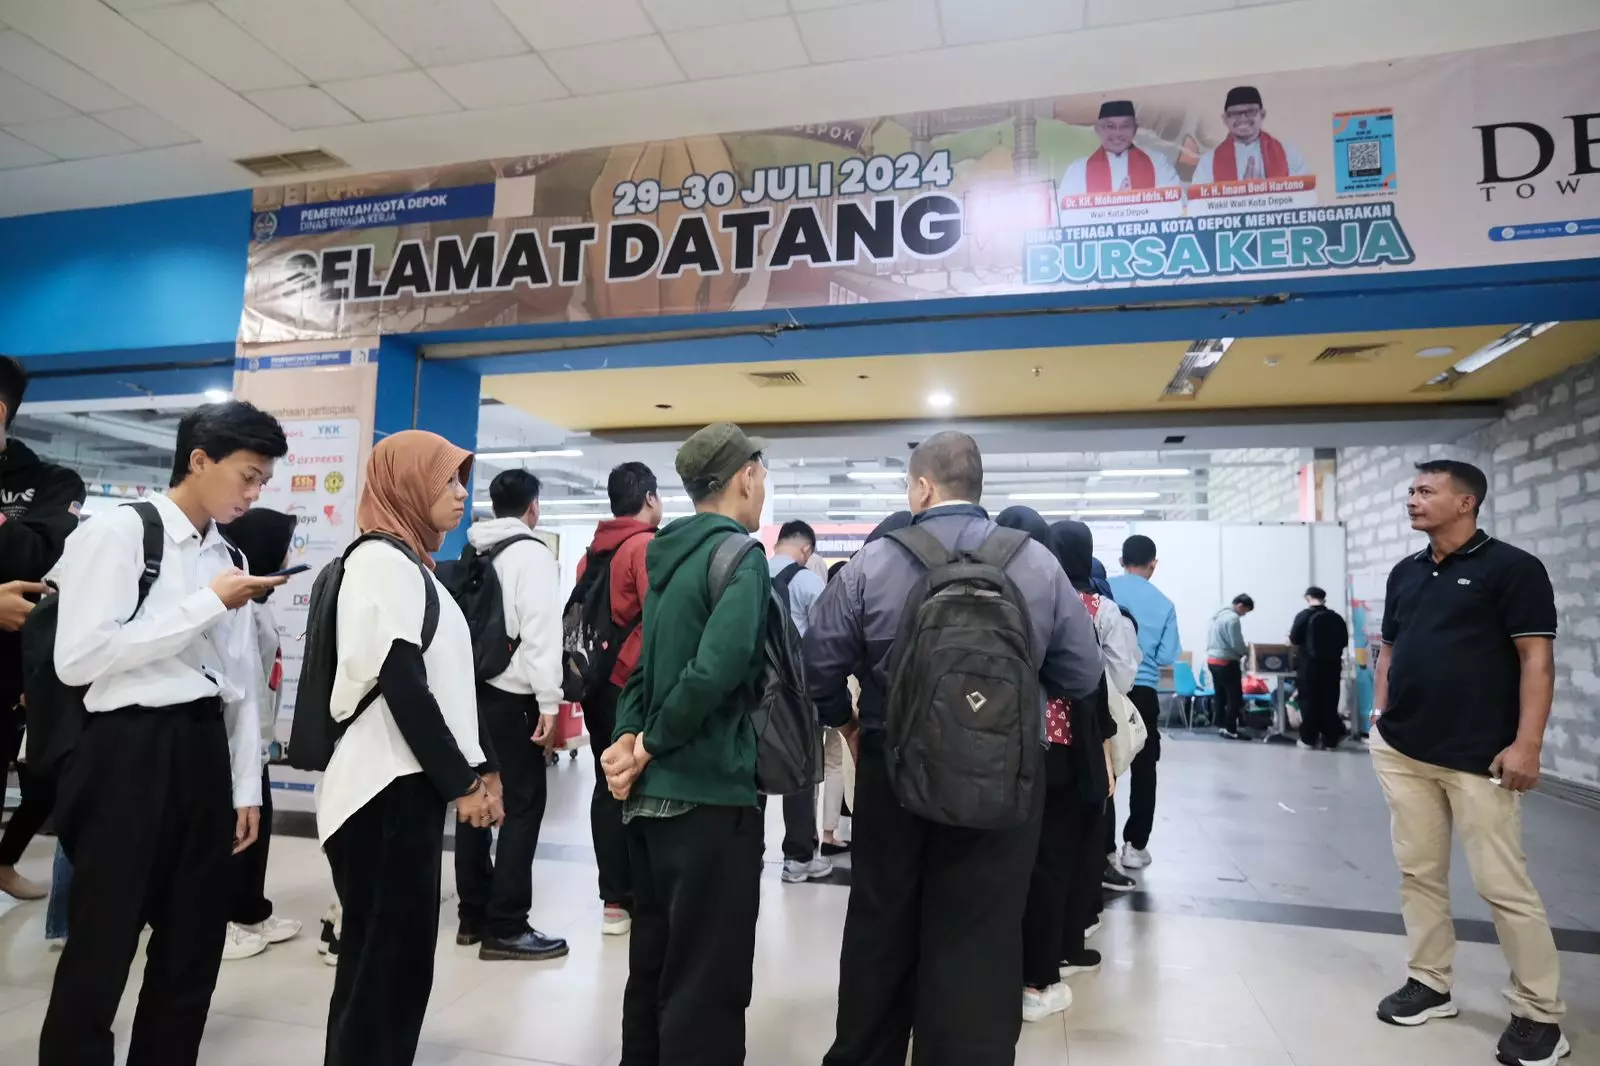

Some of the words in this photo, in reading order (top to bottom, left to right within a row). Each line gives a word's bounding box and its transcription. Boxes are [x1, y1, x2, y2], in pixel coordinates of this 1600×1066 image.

[1472, 113, 1600, 184] DE
[740, 161, 833, 204] JULI
[839, 149, 953, 196] 2024
[1222, 184, 1247, 196] Imam
[1248, 182, 1268, 194] Budi
[1269, 180, 1304, 192] Hartono
[301, 203, 372, 221] PEMERINTAH
[372, 199, 406, 213] KOTA
[407, 195, 448, 210] DEPOK
[1107, 209, 1125, 217] Kota
[1126, 207, 1150, 217] Depok
[1207, 201, 1228, 210] Wakil
[1230, 200, 1246, 209] Wali
[1248, 198, 1267, 207] Kota
[1268, 196, 1294, 207] Depok
[300, 219, 328, 232] DINAS
[367, 212, 397, 224] KERJA
[1065, 225, 1114, 241] TENAGA
[1117, 222, 1158, 237] KERJA
[1161, 219, 1194, 233] KOTA
[1197, 216, 1242, 231] DEPOK
[1245, 204, 1392, 227] MENYELENGGARAKAN
[606, 192, 963, 282] DATANG
[1026, 234, 1211, 284] BURSA
[1215, 219, 1410, 272] KERJA
[318, 425, 341, 435] YKK
